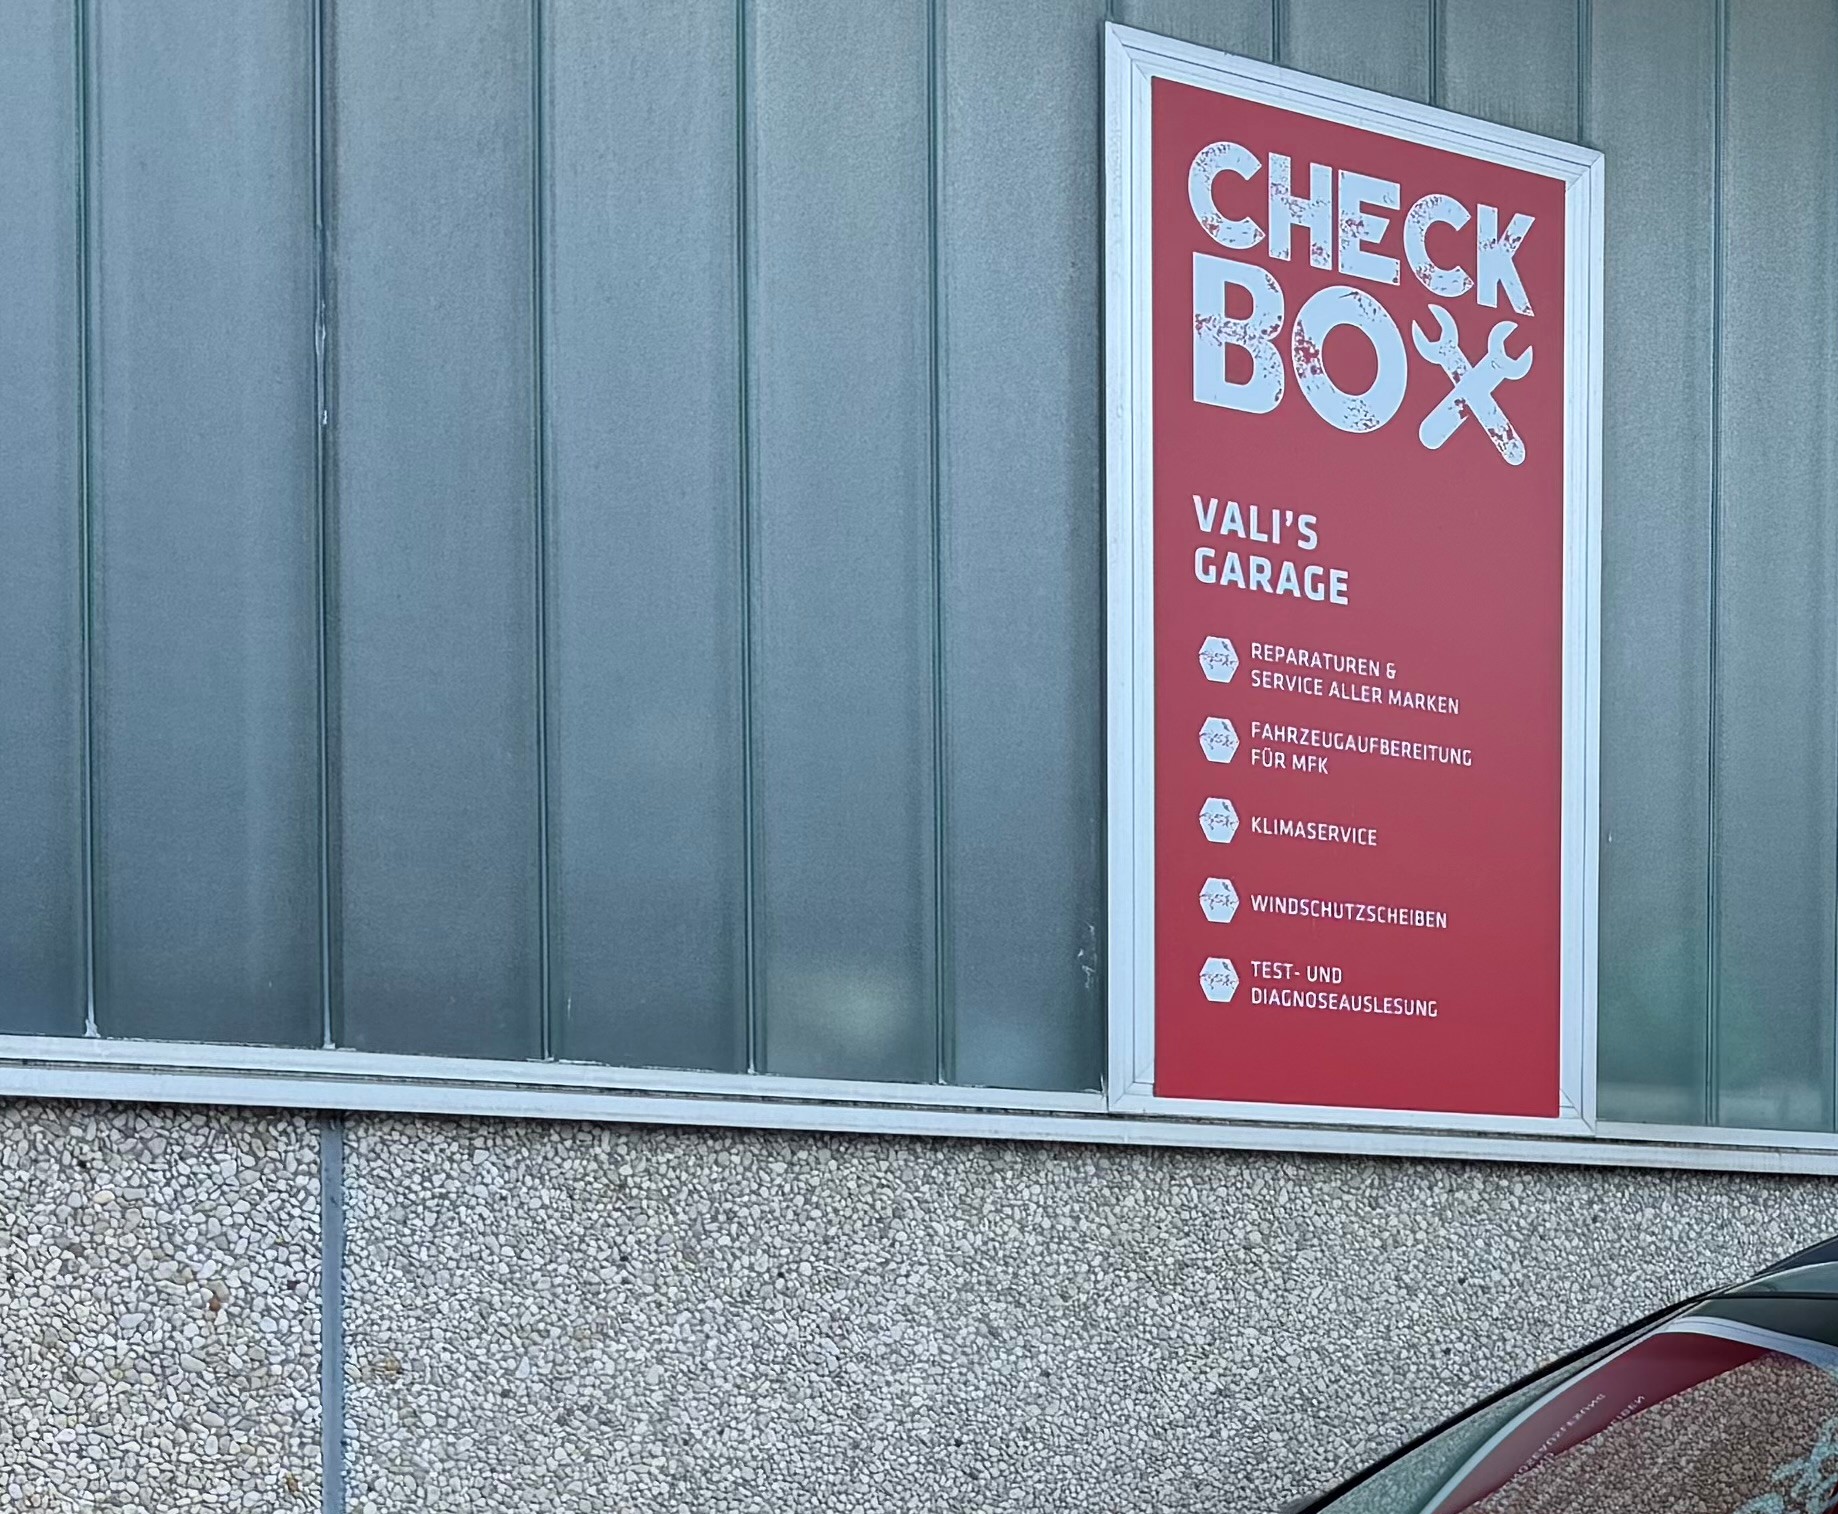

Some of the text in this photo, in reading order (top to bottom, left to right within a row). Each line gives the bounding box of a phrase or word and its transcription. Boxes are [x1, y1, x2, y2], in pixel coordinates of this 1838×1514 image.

[1188, 141, 1536, 316] CHECK
[1192, 494, 1318, 550] VALI'S
[1194, 547, 1349, 606] GARAGE
[1251, 642, 1397, 680] REPARATUREN &
[1251, 670, 1460, 715] SERVICE ALLER MARKEN
[1251, 721, 1473, 767] FAHRZEUGAUFBEREITUNG
[1251, 748, 1329, 774] FÜR MFK
[1251, 816, 1377, 846] KLIMASERVICE
[1251, 895, 1447, 929] WINDSCHUTZSCHEIBEN
[1251, 960, 1343, 984] TEST- UND
[1251, 987, 1438, 1018] DIAGNOSEAUSLESUNG
